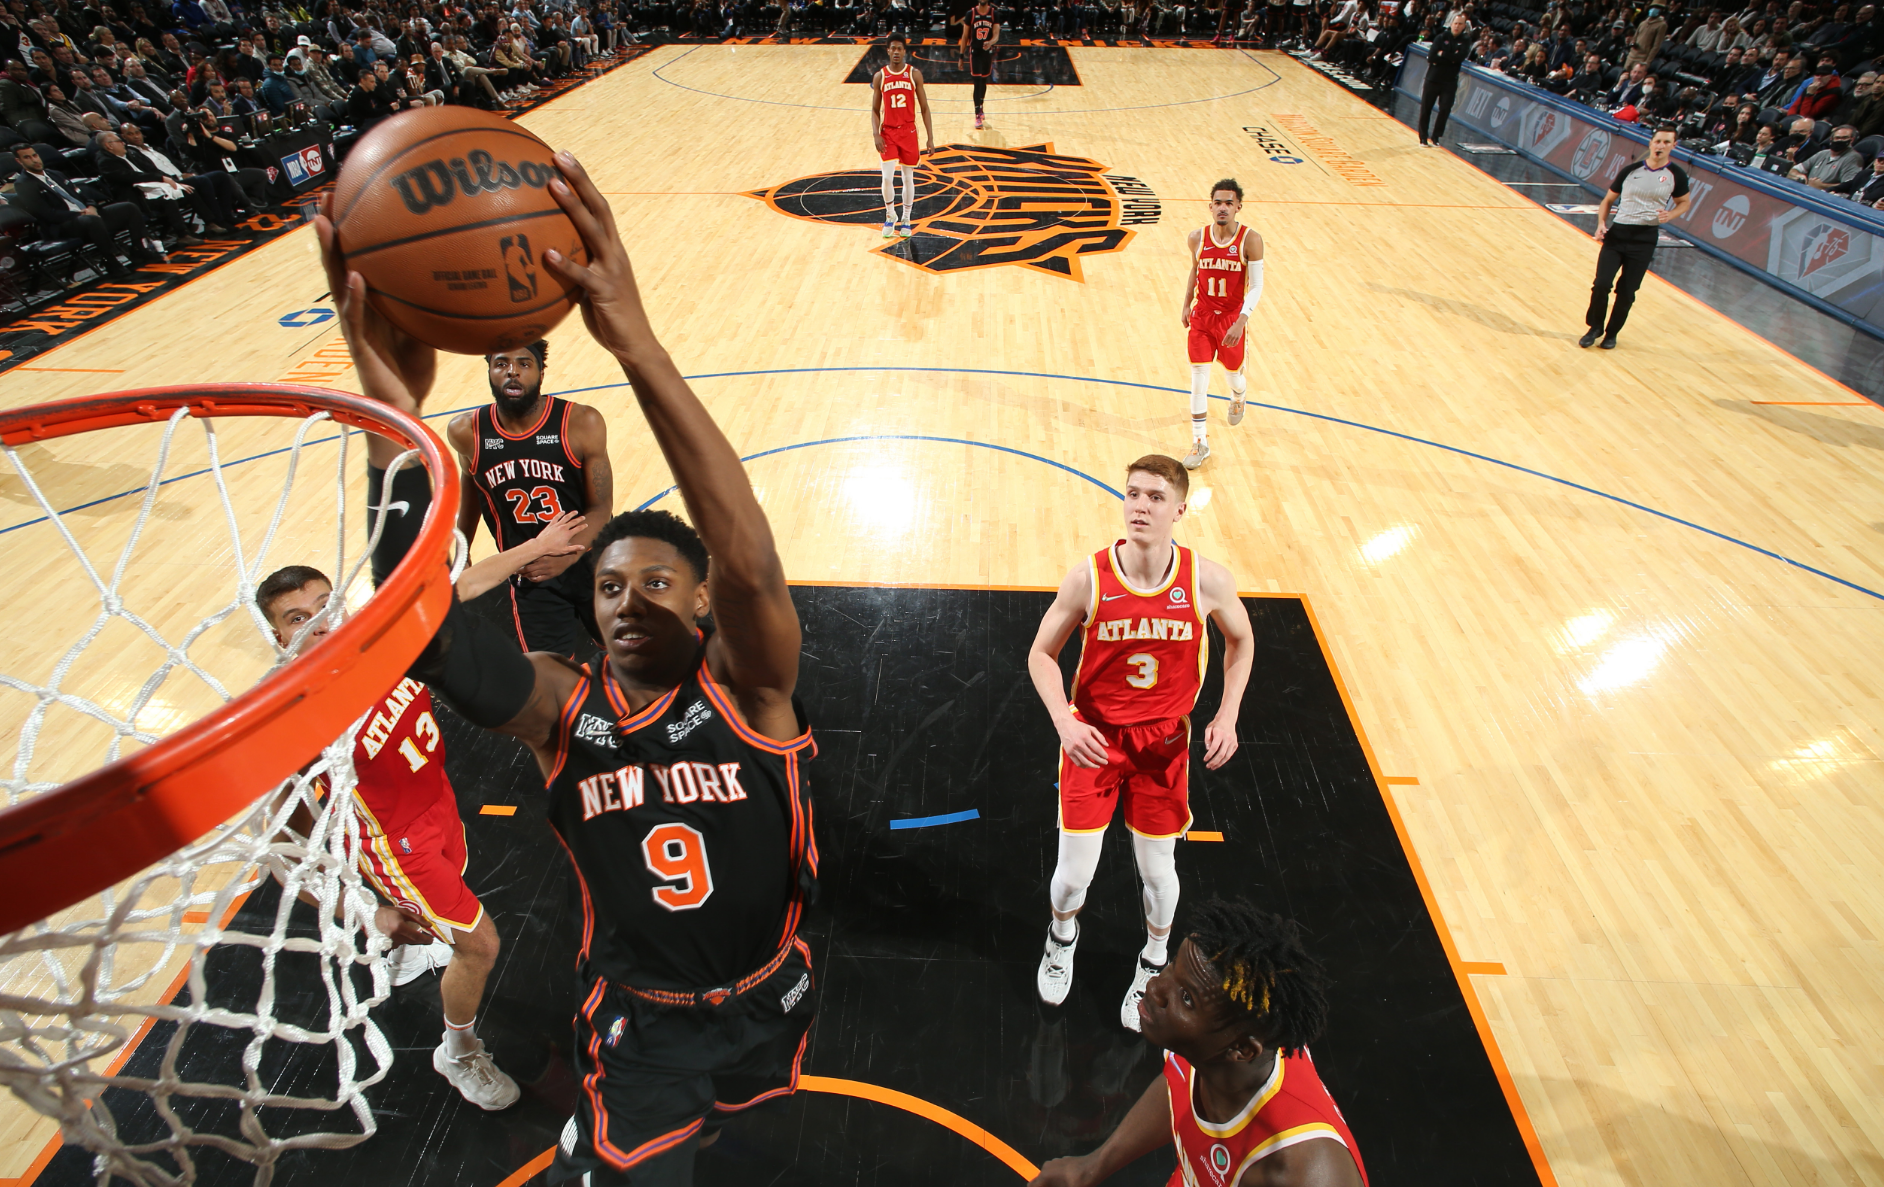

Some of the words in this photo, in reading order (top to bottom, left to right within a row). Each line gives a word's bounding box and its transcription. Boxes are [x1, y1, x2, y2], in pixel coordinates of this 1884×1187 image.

[976, 27, 990, 40] 67
[883, 80, 913, 93] ATLANTA
[890, 93, 907, 109] 12
[1465, 86, 1493, 120] NEXT
[1242, 126, 1293, 154] CHASE
[1325, 160, 1389, 187] GARDEN
[1604, 153, 1626, 180] VS
[1101, 174, 1157, 197] NEW
[925, 143, 1128, 273] KNICKS
[1119, 198, 1162, 226] YORK
[1199, 257, 1242, 272] ATLANTA
[1207, 276, 1228, 298] 11
[0, 280, 168, 336] YORK
[484, 460, 516, 490] NEW
[518, 458, 565, 483] YORK
[505, 485, 564, 524] 23
[1097, 617, 1194, 642] ATLANTA
[1125, 653, 1160, 690] 3
[398, 711, 440, 773] 13
[669, 717, 703, 744] SPACE
[577, 762, 645, 822] NEW
[648, 760, 748, 805] YORK
[641, 822, 714, 913] 9
